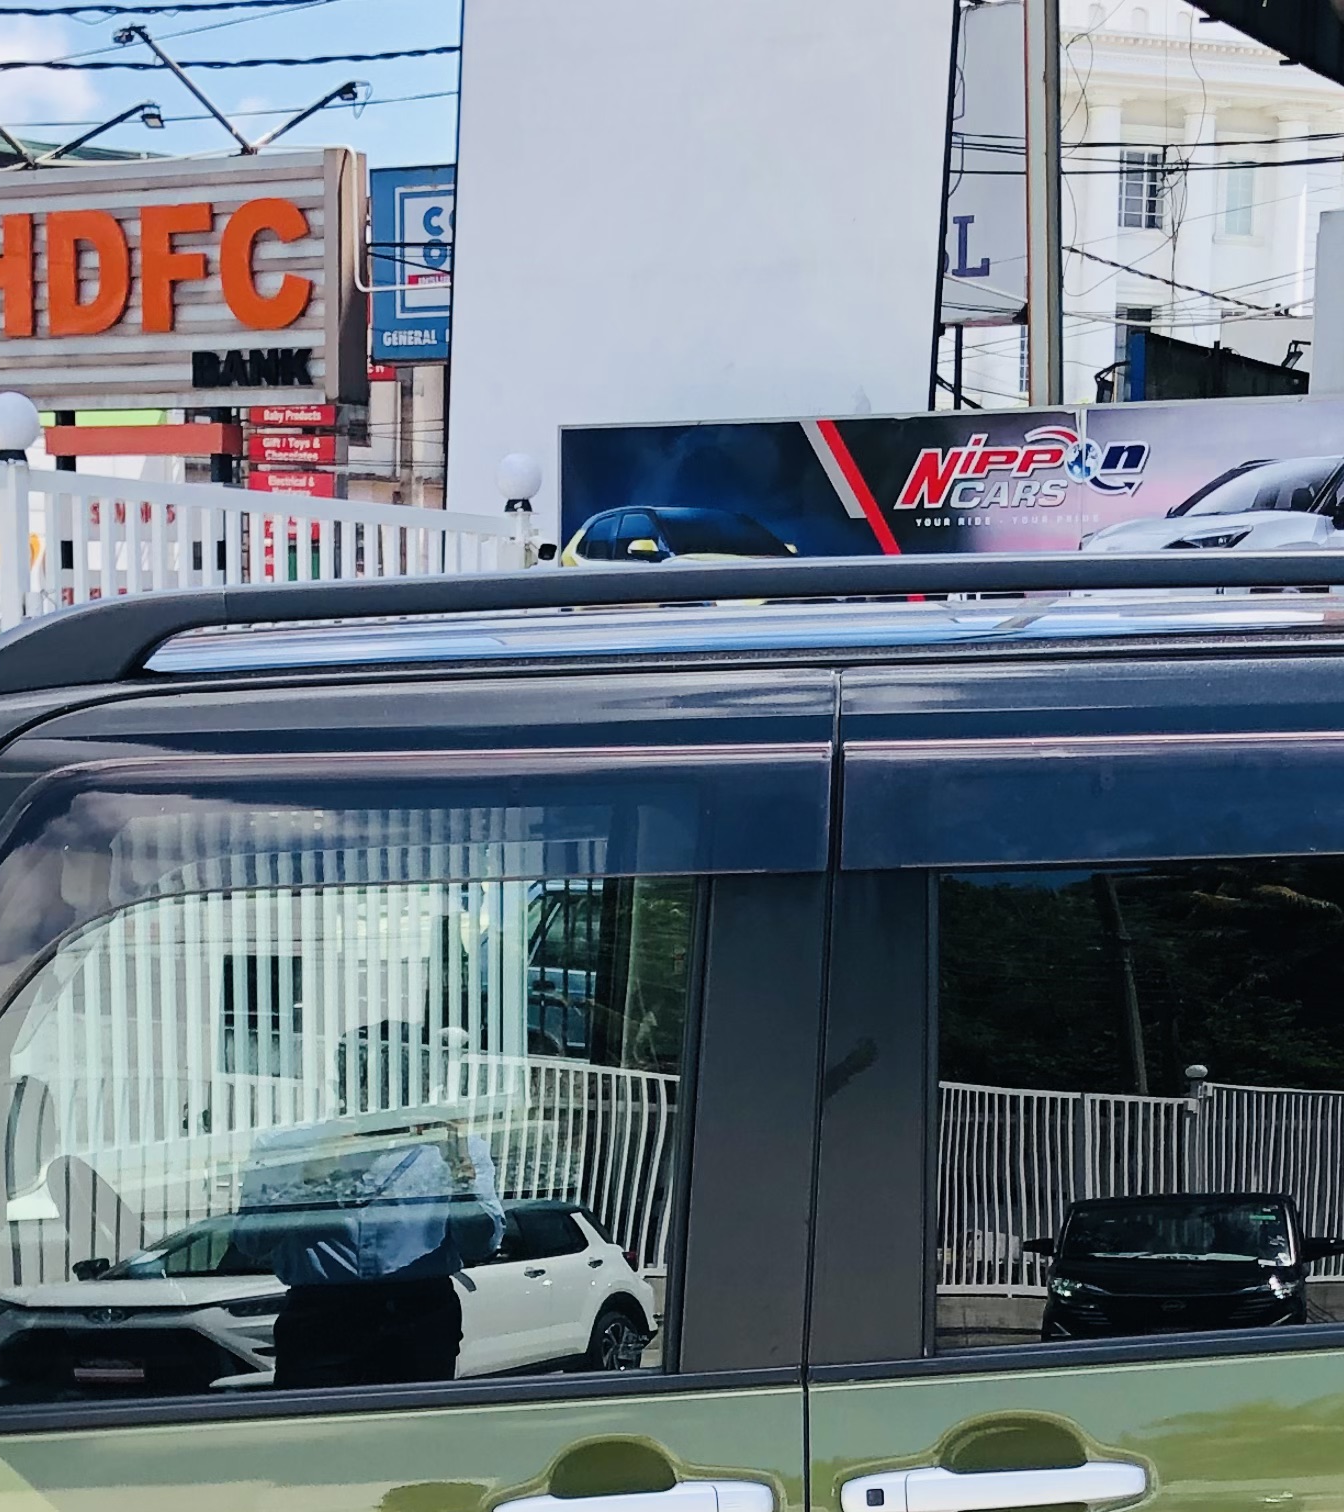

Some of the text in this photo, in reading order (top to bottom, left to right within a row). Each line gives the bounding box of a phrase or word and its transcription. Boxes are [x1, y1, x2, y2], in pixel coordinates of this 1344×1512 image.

[423, 206, 454, 237] C
[382, 329, 438, 347] GENERAL
[192, 348, 313, 389] BANK
[264, 410, 322, 424] Baby Products
[262, 437, 281, 448] Gift
[288, 437, 311, 451] Toys
[313, 437, 321, 449] &
[950, 480, 1069, 509] CARS
[915, 517, 951, 527] YOUR
[958, 516, 992, 526] RIDE
[1012, 515, 1048, 525] YOUR
